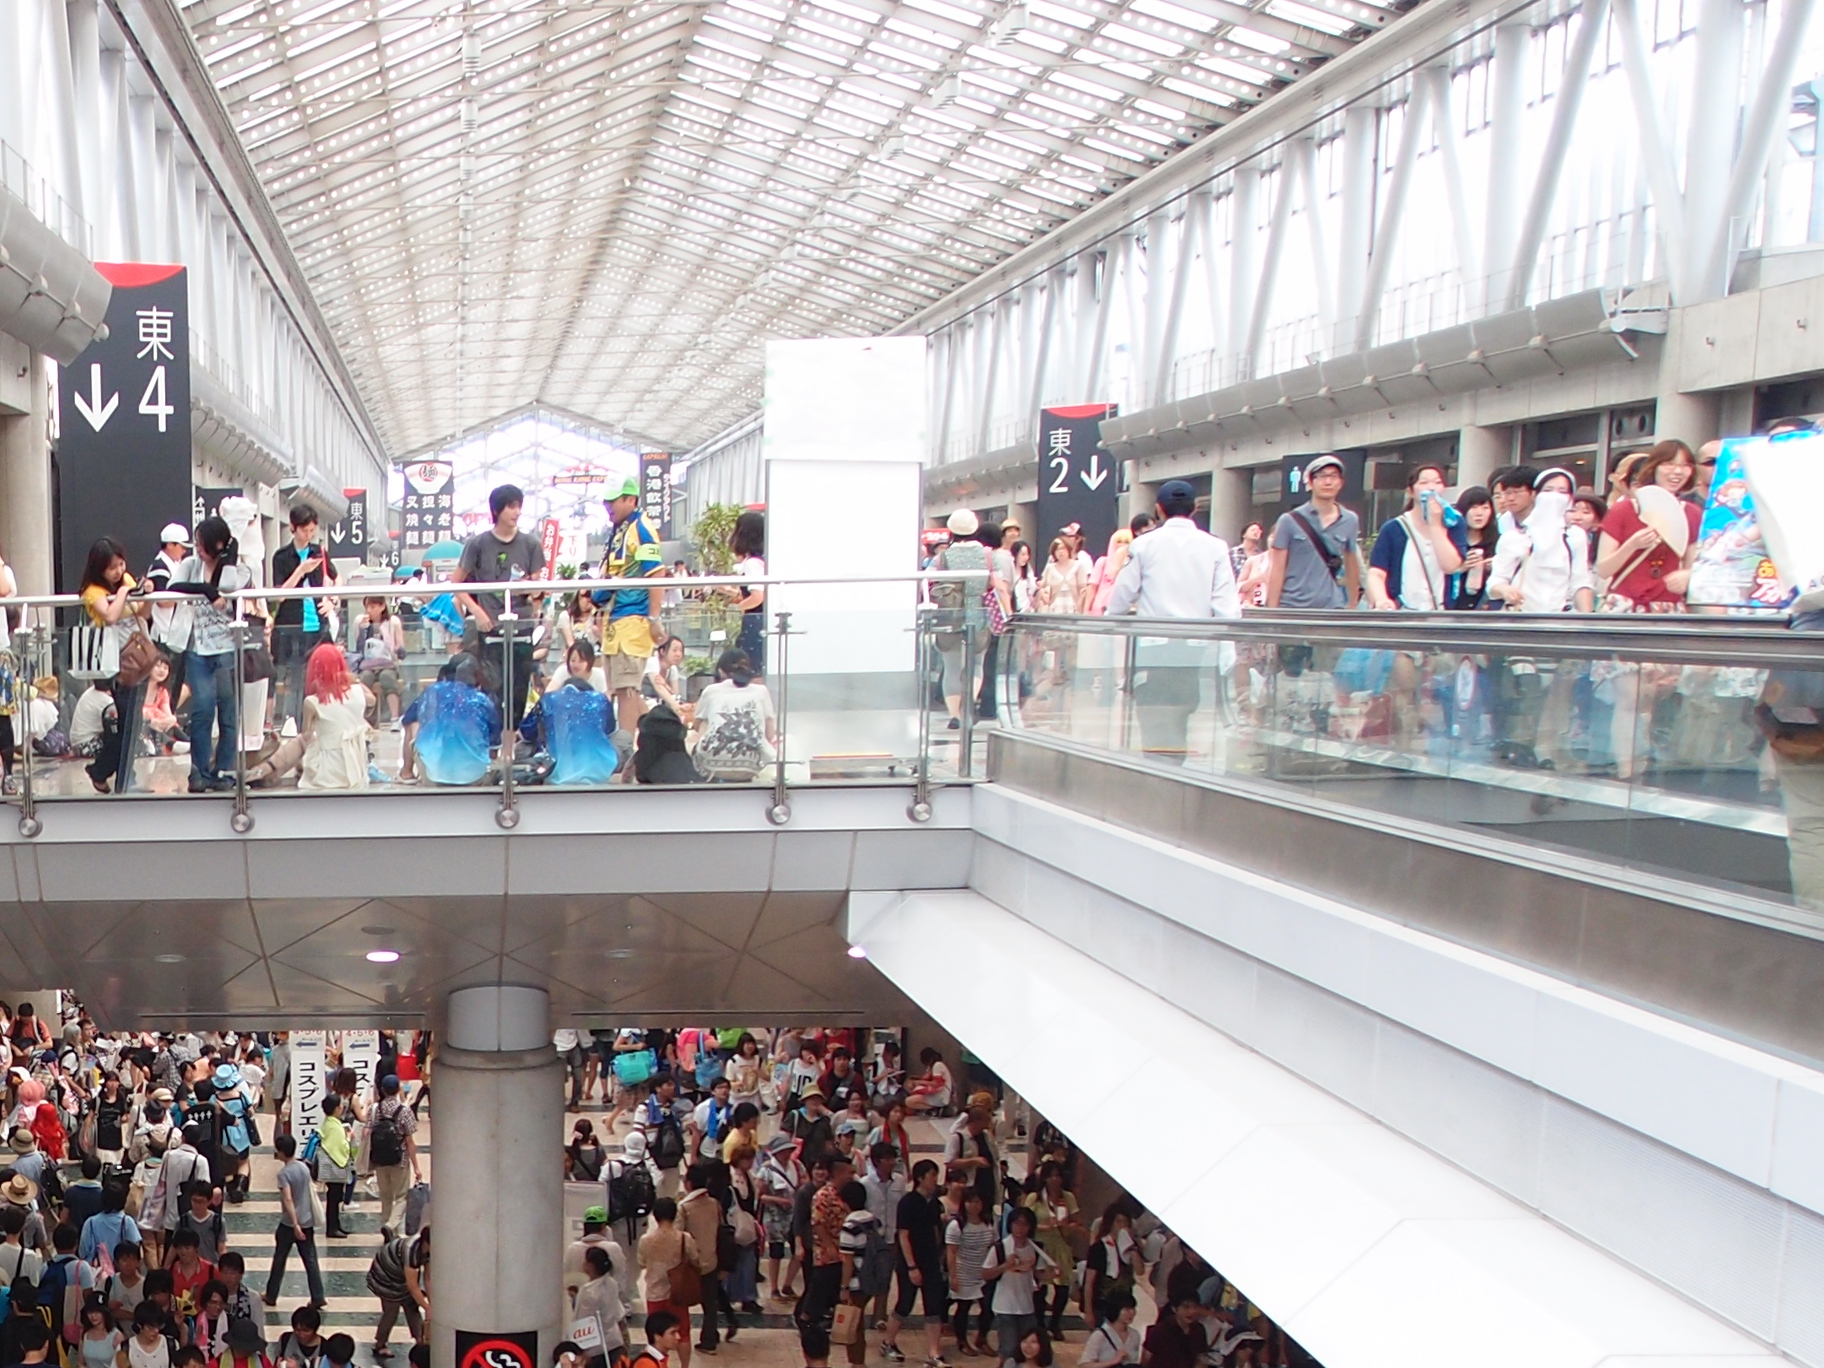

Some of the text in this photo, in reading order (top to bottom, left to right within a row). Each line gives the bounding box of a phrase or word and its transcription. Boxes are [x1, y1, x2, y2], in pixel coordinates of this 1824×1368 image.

[298, 1062, 320, 1146] コスプレエリ
